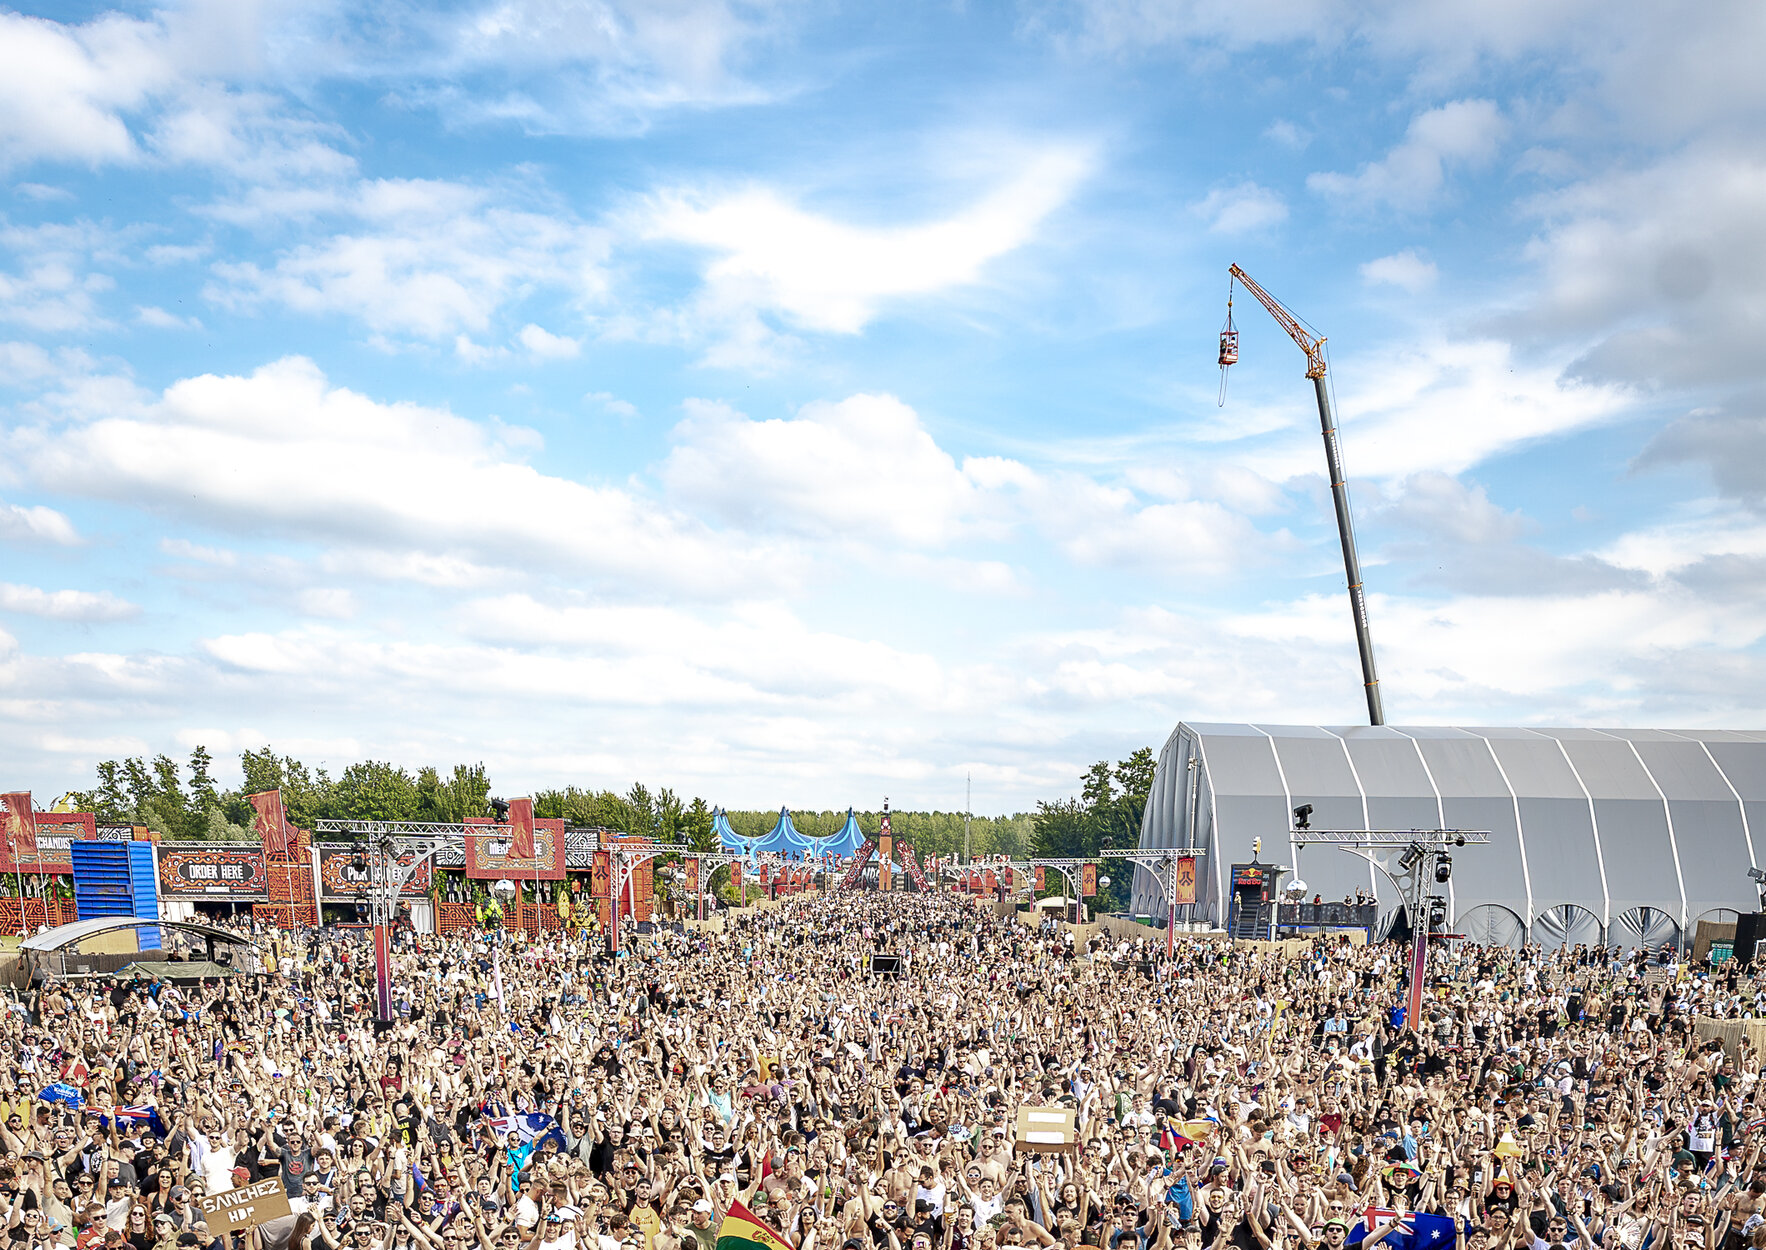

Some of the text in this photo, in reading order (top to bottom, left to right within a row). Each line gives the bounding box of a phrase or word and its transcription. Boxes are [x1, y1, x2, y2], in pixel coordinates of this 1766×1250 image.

[37, 837, 71, 849] CHANDIS
[189, 865, 244, 879] ORDER HERE
[202, 1180, 280, 1213] SANCHEZ
